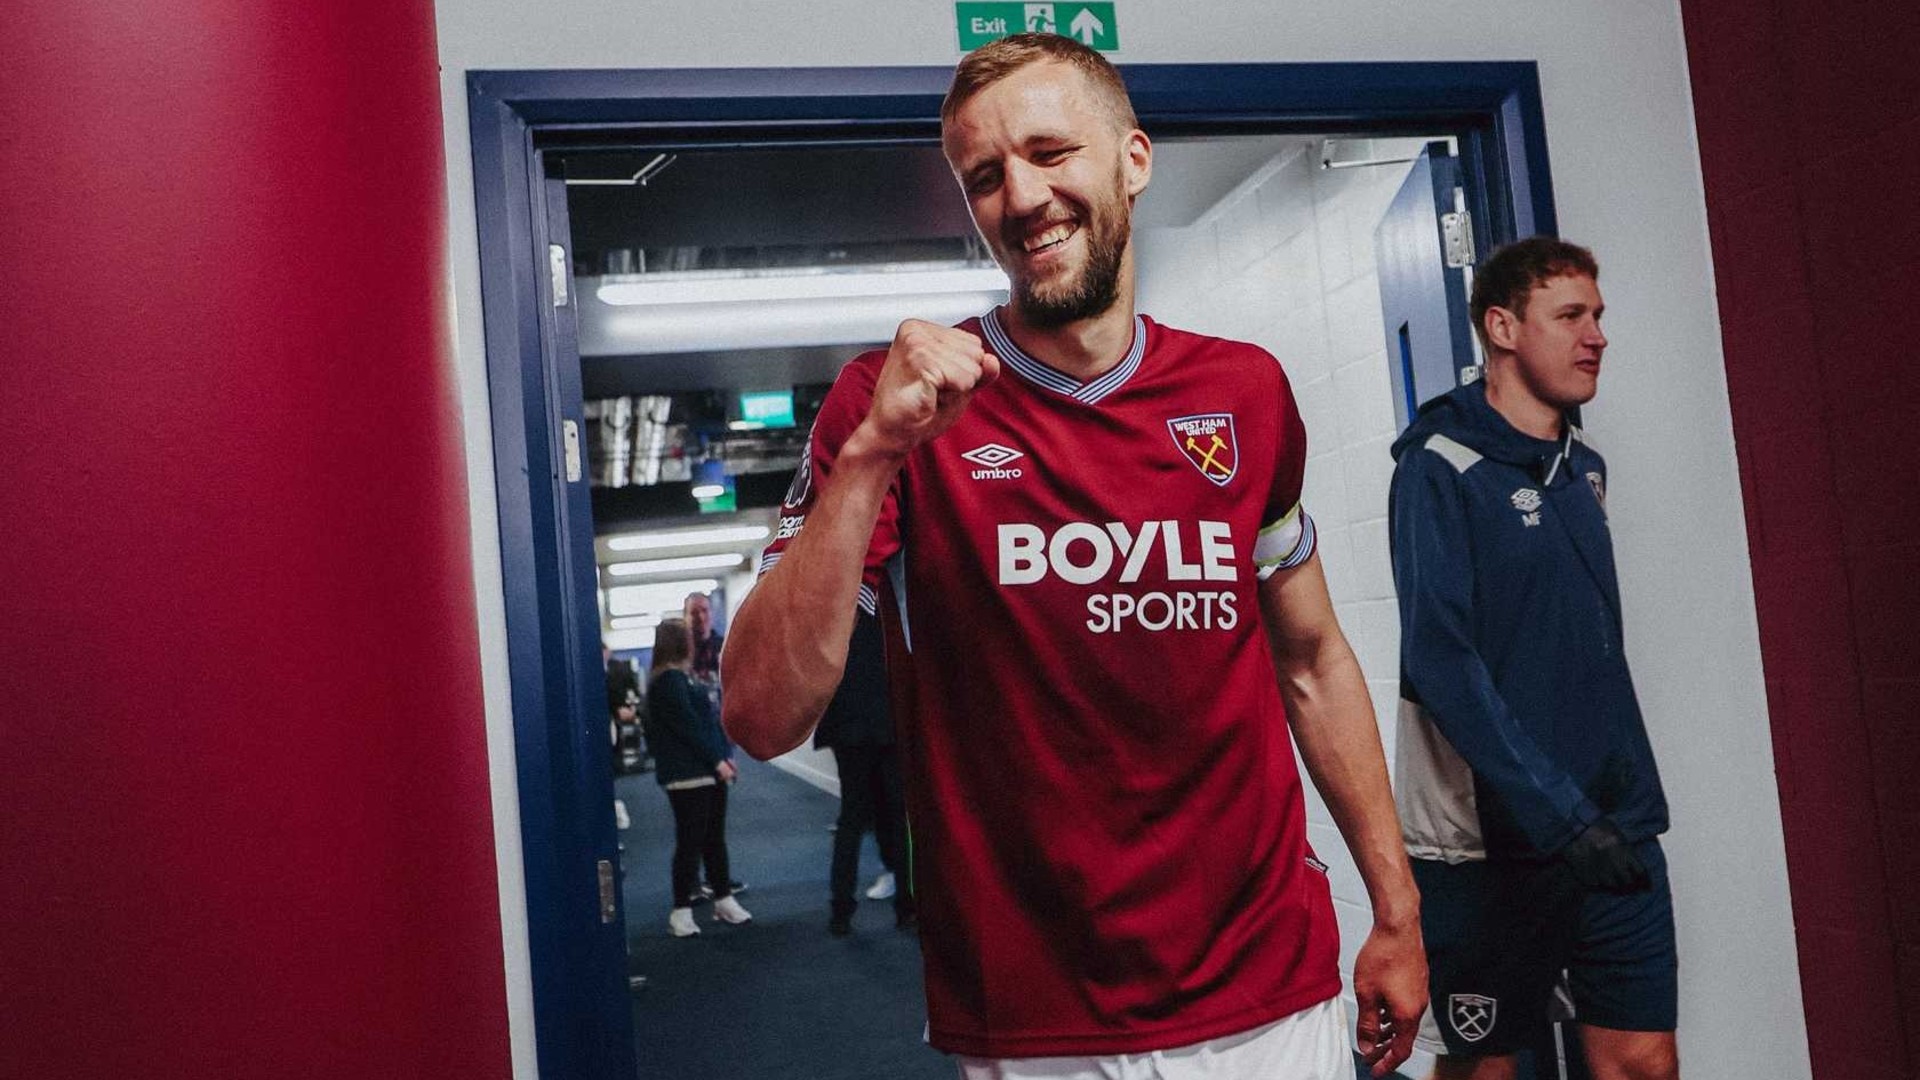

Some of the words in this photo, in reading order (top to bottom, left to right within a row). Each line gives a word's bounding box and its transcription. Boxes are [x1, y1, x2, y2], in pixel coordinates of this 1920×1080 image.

[970, 17, 1007, 34] Exit
[1174, 420, 1200, 432] WEST
[1201, 418, 1227, 428] HAM
[1186, 426, 1217, 436] UNITED
[971, 467, 1022, 480] umbro
[1521, 511, 1542, 527] MF
[997, 520, 1238, 585] BOYLE
[1086, 591, 1238, 633] SPORTS
